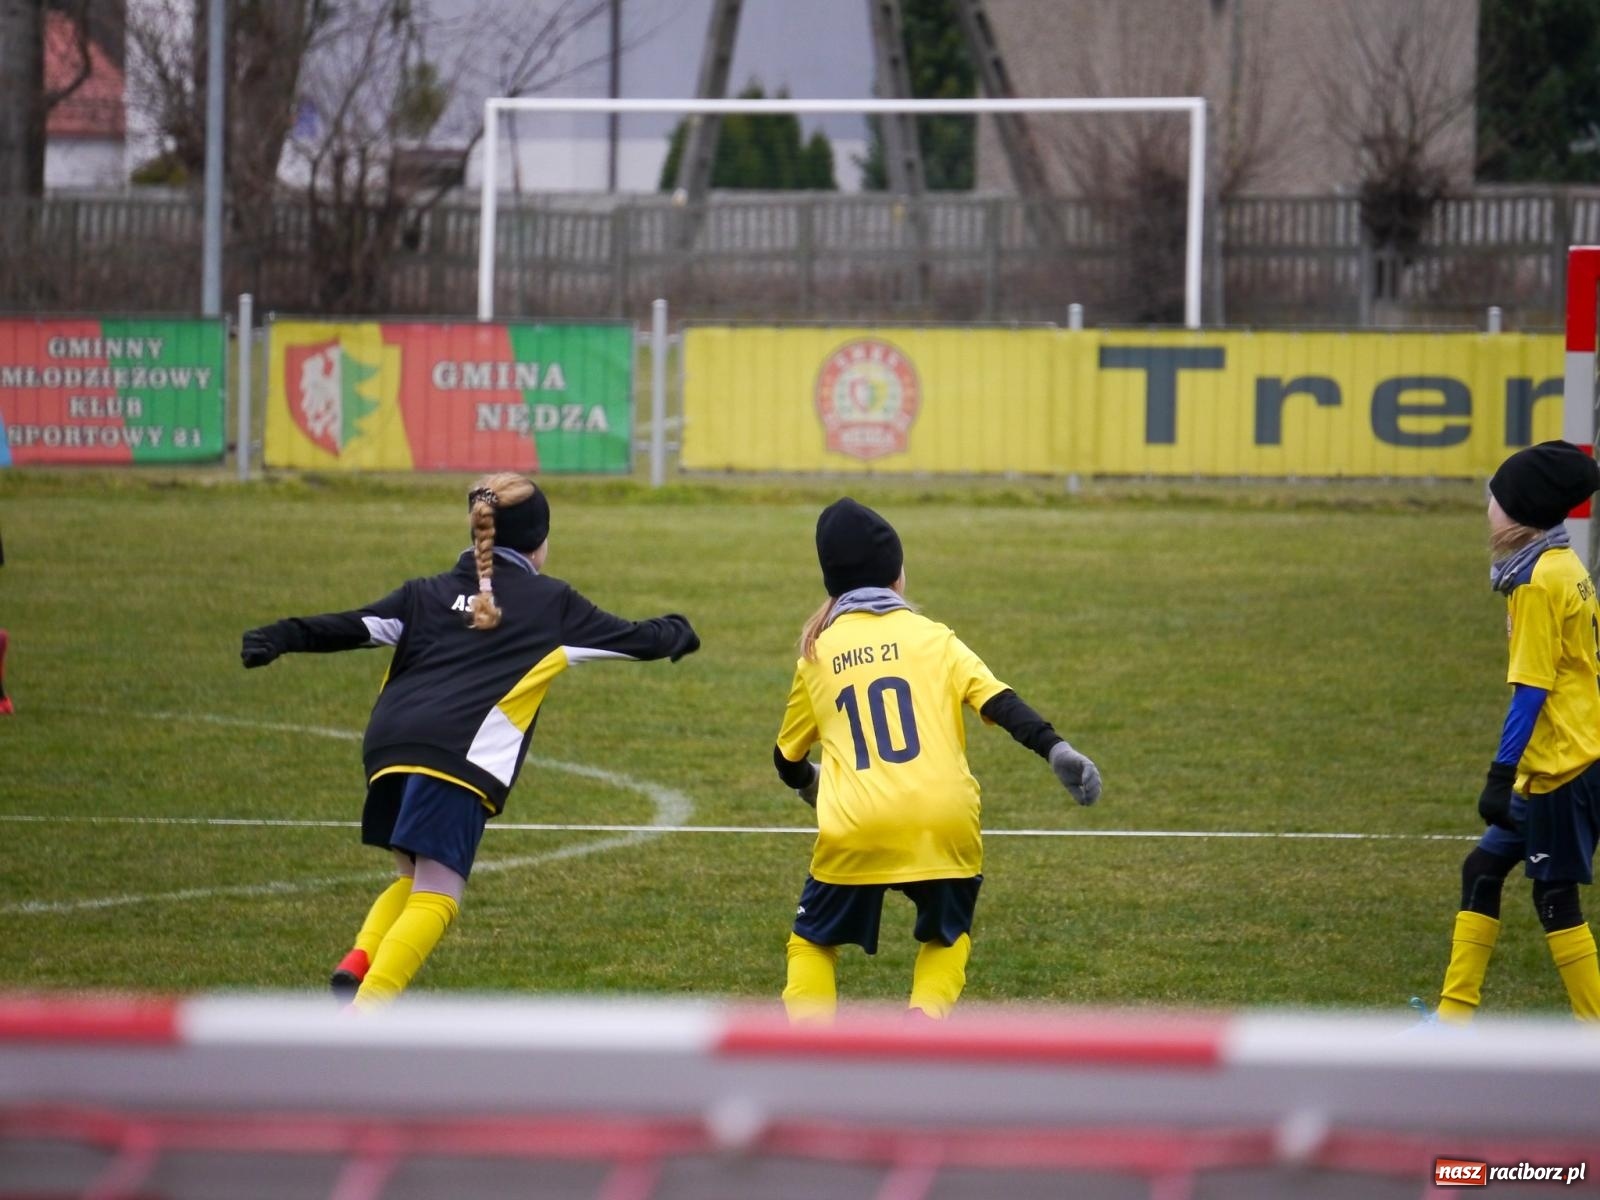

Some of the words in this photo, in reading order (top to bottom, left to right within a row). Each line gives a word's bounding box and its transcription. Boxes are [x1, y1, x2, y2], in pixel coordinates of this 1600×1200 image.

[48, 337, 163, 359] GMINNY
[432, 360, 566, 391] GMINA
[69, 396, 143, 418] KLUB
[476, 403, 608, 438] NĘDZA
[8, 425, 163, 447] SPORTOWY
[832, 646, 875, 675] GMKS
[880, 642, 900, 662] 21
[835, 676, 921, 771] 10
